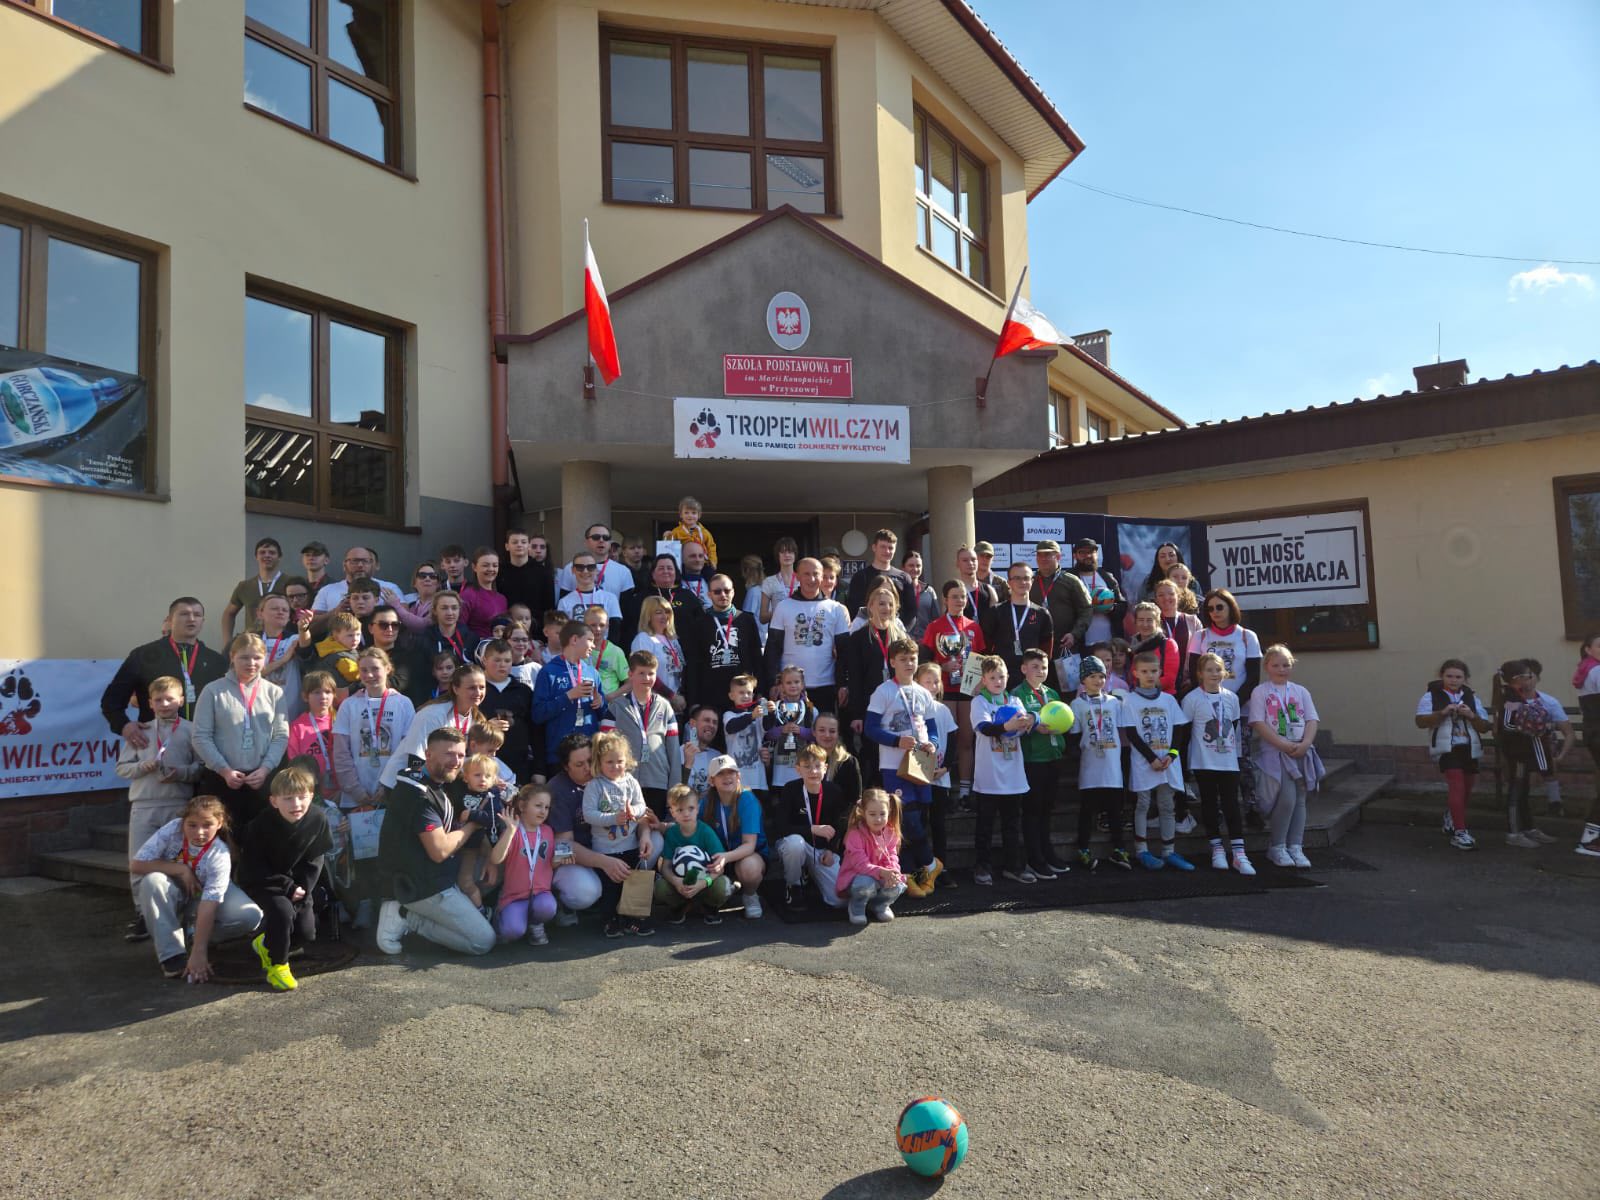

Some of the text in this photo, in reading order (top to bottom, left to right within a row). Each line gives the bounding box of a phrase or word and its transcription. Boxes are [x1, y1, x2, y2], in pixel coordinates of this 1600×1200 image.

[727, 358, 849, 374] SZKOŁA PODSTAWOWA nr 1
[745, 374, 757, 382] im.
[768, 384, 819, 395] Przyszowej
[1026, 528, 1063, 536] SPONSORZY
[1226, 559, 1349, 588] I DEMOKRACJA
[2, 739, 121, 770] WILCZYM
